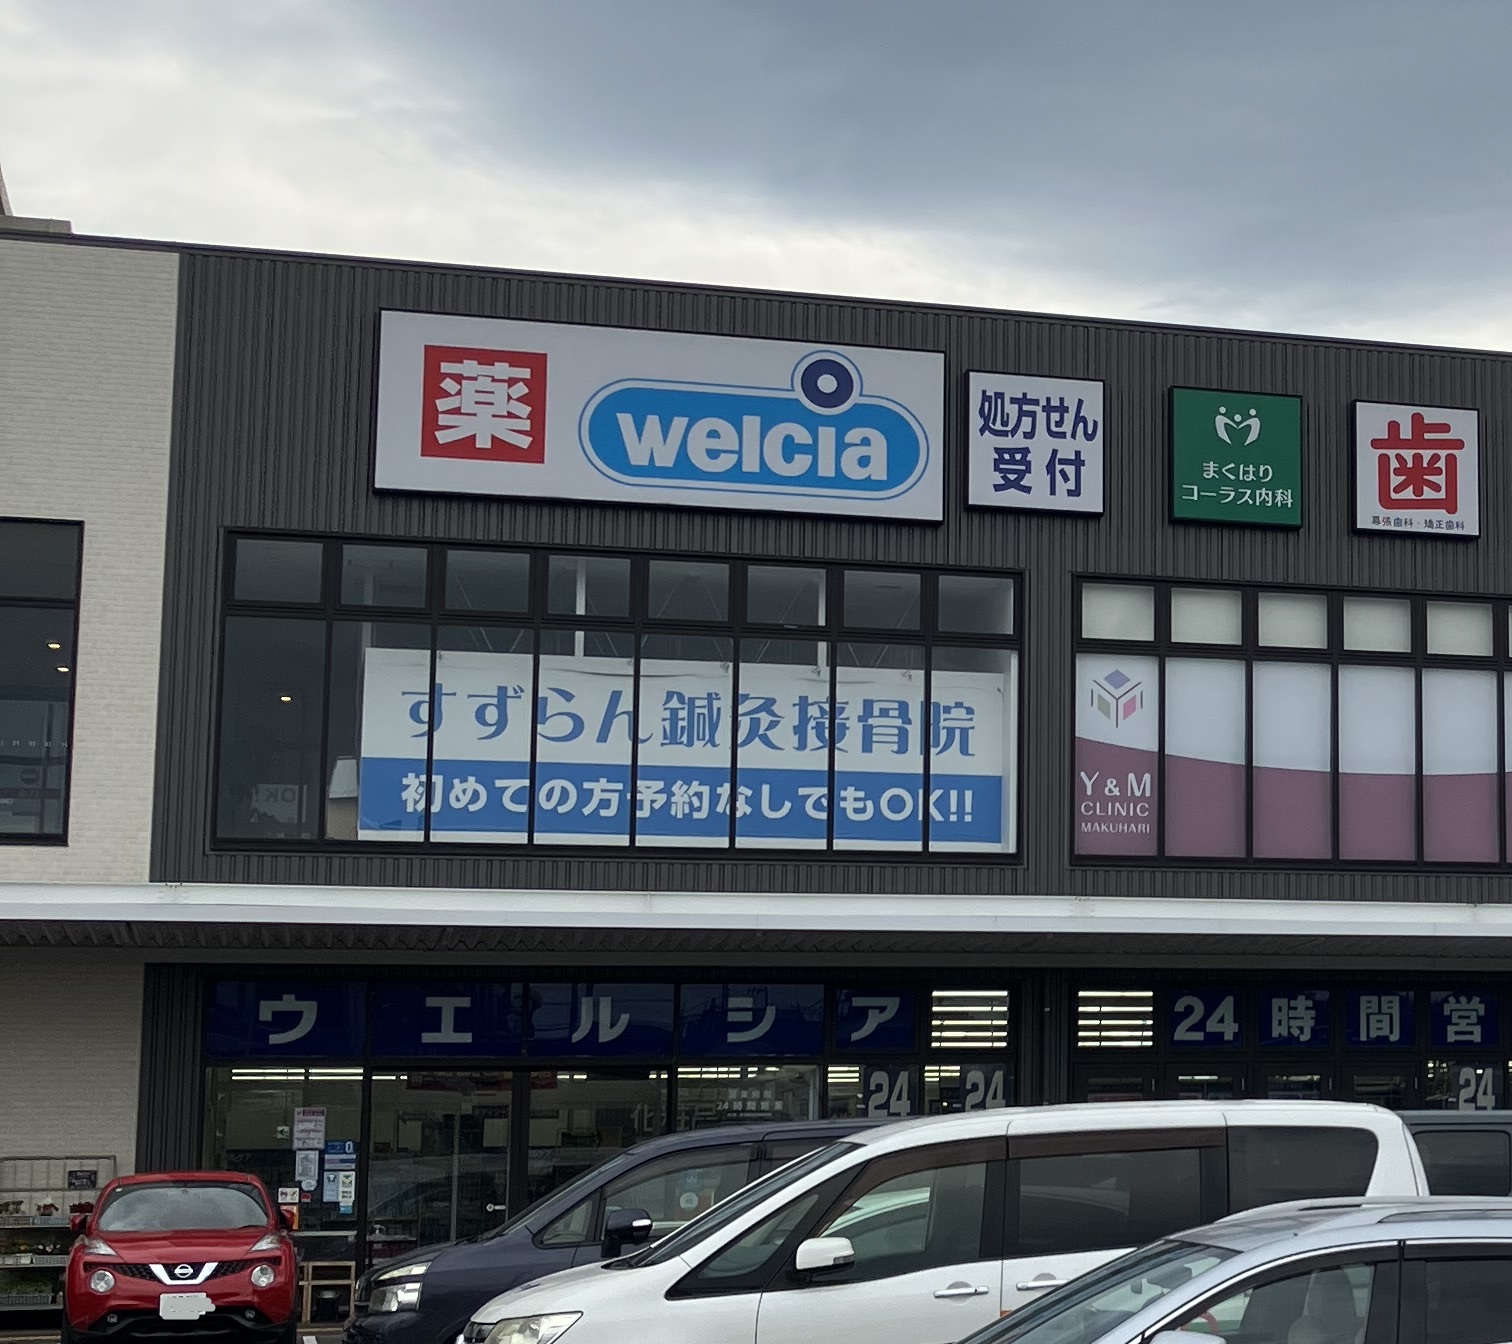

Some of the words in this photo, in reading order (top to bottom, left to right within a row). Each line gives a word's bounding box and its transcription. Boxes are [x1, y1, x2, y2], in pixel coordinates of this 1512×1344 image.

[433, 359, 533, 450] 薬
[977, 388, 1099, 444] 処方せん
[616, 411, 888, 482] welcia
[992, 445, 1087, 499] 受付
[1202, 460, 1273, 483] まくはり
[1370, 412, 1465, 515] 歯
[1181, 484, 1293, 508] コーラス内科
[400, 681, 977, 759] すずらん鍼灸接骨院
[1080, 801, 1150, 817] CLINIC
[1081, 821, 1151, 834] MAKUHARI
[257, 993, 902, 1046] ウエルシア
